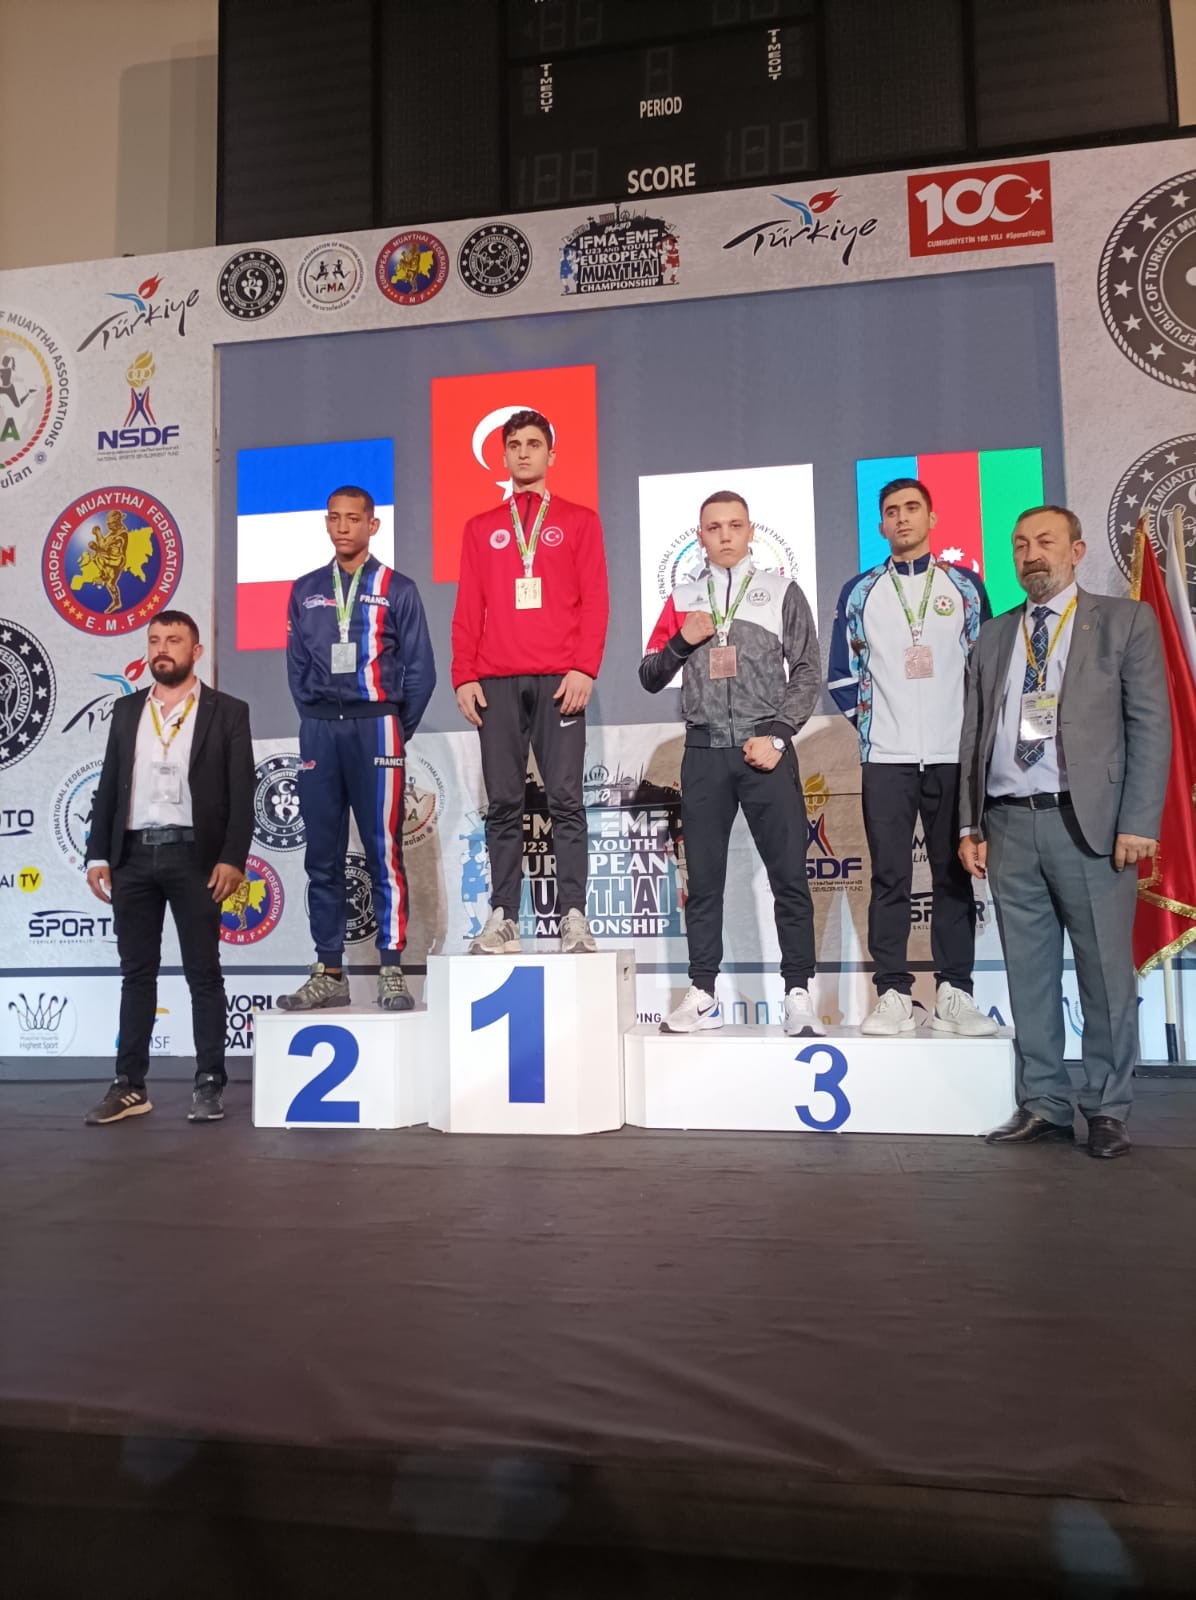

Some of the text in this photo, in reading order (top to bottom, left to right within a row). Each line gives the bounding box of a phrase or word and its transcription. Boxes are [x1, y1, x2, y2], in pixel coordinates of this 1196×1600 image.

[767, 28, 782, 81] TIMEOUT
[539, 63, 553, 113] TIMEOUT
[640, 96, 682, 119] PERIOD
[627, 163, 696, 194] SCORE
[580, 229, 659, 250] IFMA-EMF
[622, 242, 653, 251] YOUTH
[722, 218, 878, 266] Türkiye
[1145, 228, 1178, 280] TURKEY
[379, 249, 391, 290] EUROPEAN
[392, 233, 429, 247] MUAYTHAI
[580, 249, 659, 266] EUROPEAN
[580, 259, 660, 285] MUAYTHAI
[315, 282, 345, 294] IFMA
[580, 278, 659, 292] CHAMPIONSHIP
[1145, 283, 1159, 302] OF
[76, 289, 200, 352] Türkiye
[1149, 302, 1196, 347] EPUBLIC
[7, 312, 59, 355] MUAYTHAI
[44, 354, 69, 448] ASSOCIATIONS
[97, 425, 180, 451] NSDF
[1152, 467, 1196, 502] MUAYT
[48, 492, 177, 600] EUROPEAN MUAYTHAI FEDERATION
[374, 757, 405, 767] FRANCE
[0, 809, 34, 828] TO
[53, 788, 69, 855] INTERNATIONAL
[65, 759, 104, 789] FEDERATIO
[592, 838, 657, 851] YOUTH
[20, 873, 40, 888] TV
[261, 866, 281, 921] FEDERATION
[470, 965, 546, 1104] 1
[284, 1024, 361, 1122] 2
[794, 1043, 852, 1131] 3
